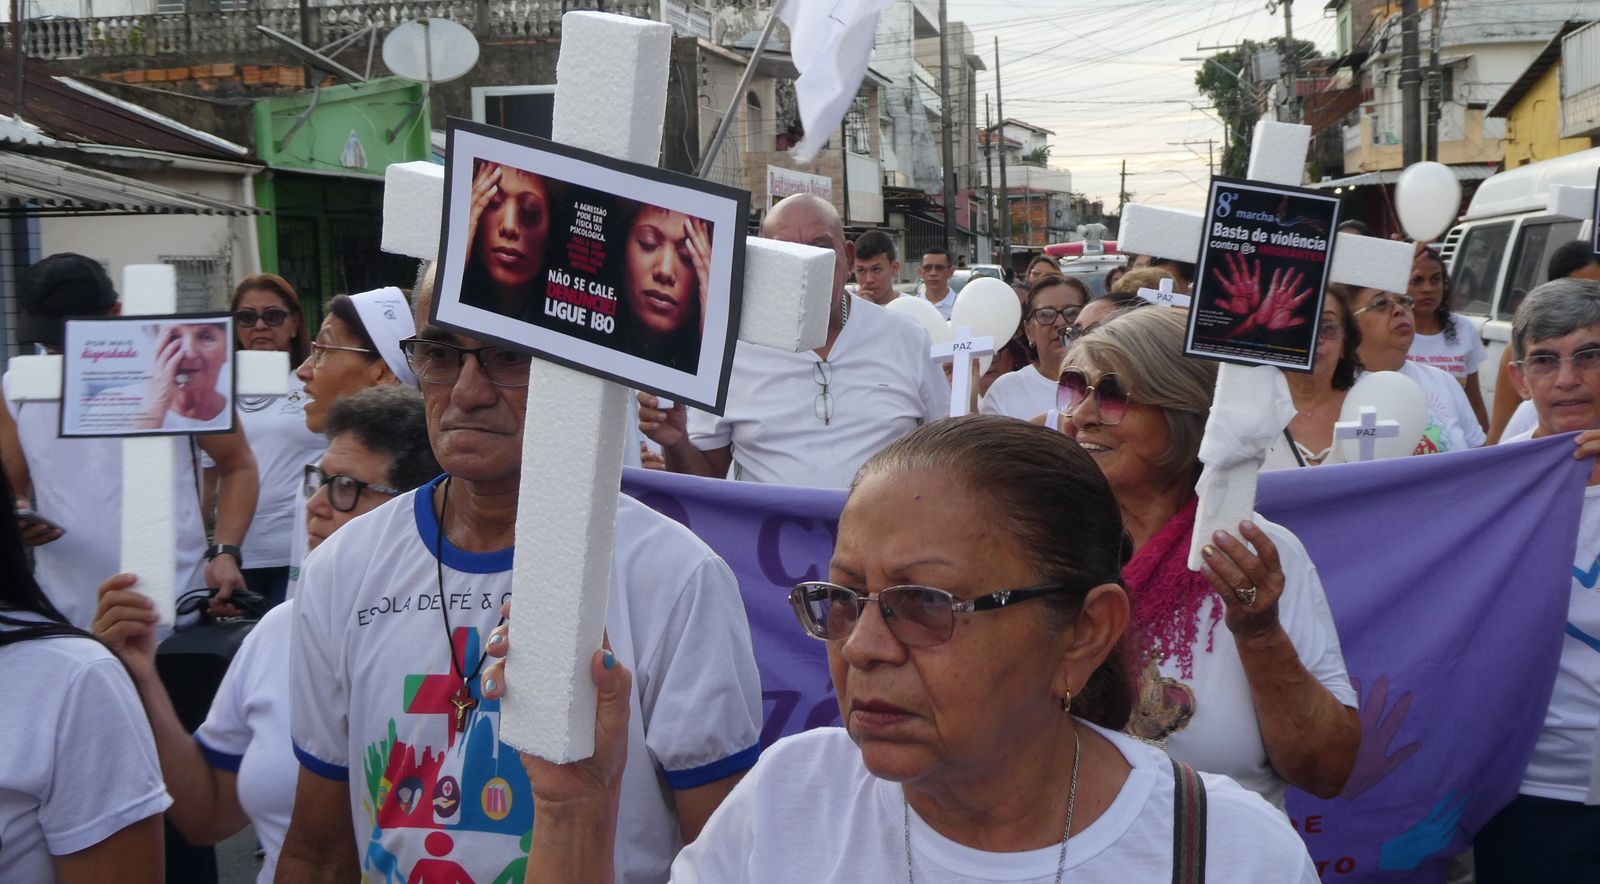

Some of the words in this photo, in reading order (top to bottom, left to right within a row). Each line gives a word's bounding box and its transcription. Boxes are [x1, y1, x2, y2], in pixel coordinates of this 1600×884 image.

[573, 201, 579, 209] A
[580, 203, 608, 217] AGRESSÃO
[1235, 209, 1274, 222] marcha
[576, 211, 592, 221] PODE
[592, 215, 603, 225] SER
[593, 224, 603, 232] OU
[1213, 222, 1249, 241] Basta
[1251, 226, 1268, 243] de
[1270, 231, 1327, 251] violência
[1209, 240, 1239, 252] contra
[1240, 242, 1256, 255] @s
[548, 268, 571, 287] NÃO
[573, 276, 586, 292] SE
[588, 281, 617, 301] CALE.
[1156, 292, 1173, 302] PAZ
[544, 297, 587, 326] LIGUE
[590, 311, 615, 334] 180
[953, 341, 972, 351] PAZ
[1356, 428, 1377, 437] PAZ
[357, 596, 411, 626] ESOLA
[418, 594, 442, 611] DE
[450, 587, 472, 610] FÉ
[481, 593, 492, 610] &
